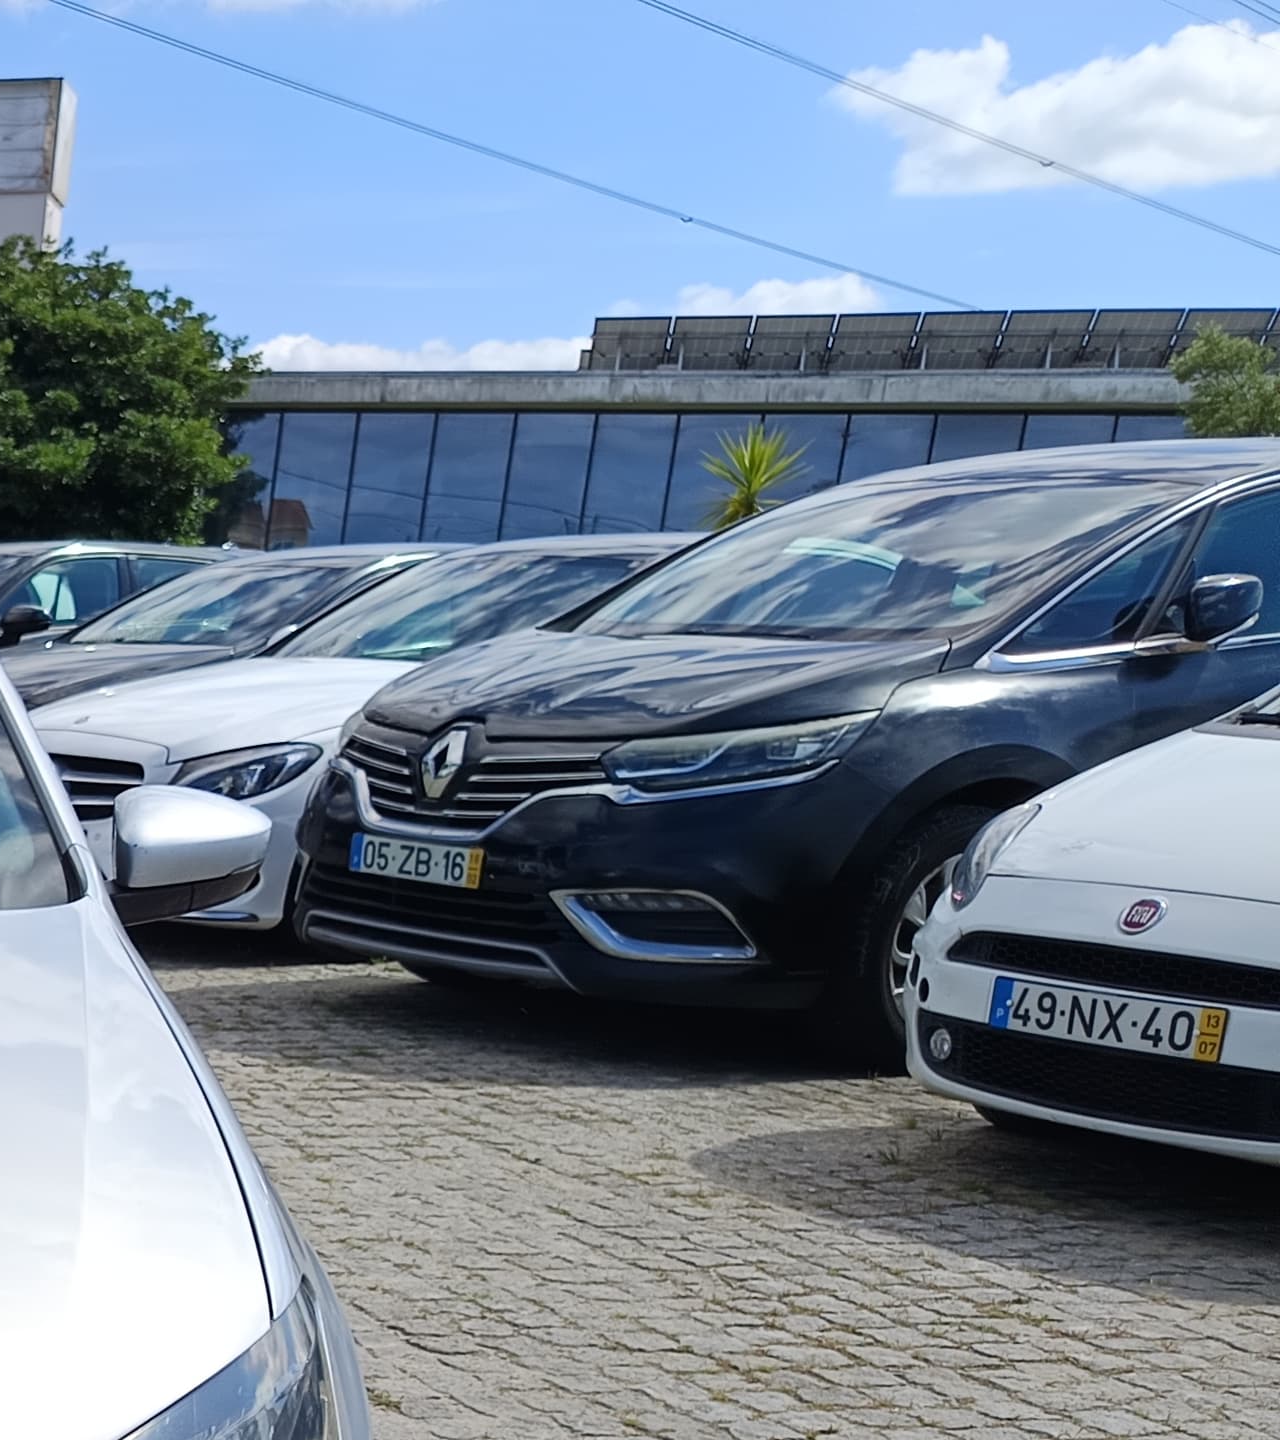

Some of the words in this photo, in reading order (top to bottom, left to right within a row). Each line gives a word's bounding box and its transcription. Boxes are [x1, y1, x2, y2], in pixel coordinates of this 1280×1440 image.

[1128, 905, 1156, 924] FIAT
[1206, 1014, 1220, 1029] 13
[1198, 1041, 1217, 1056] 07
